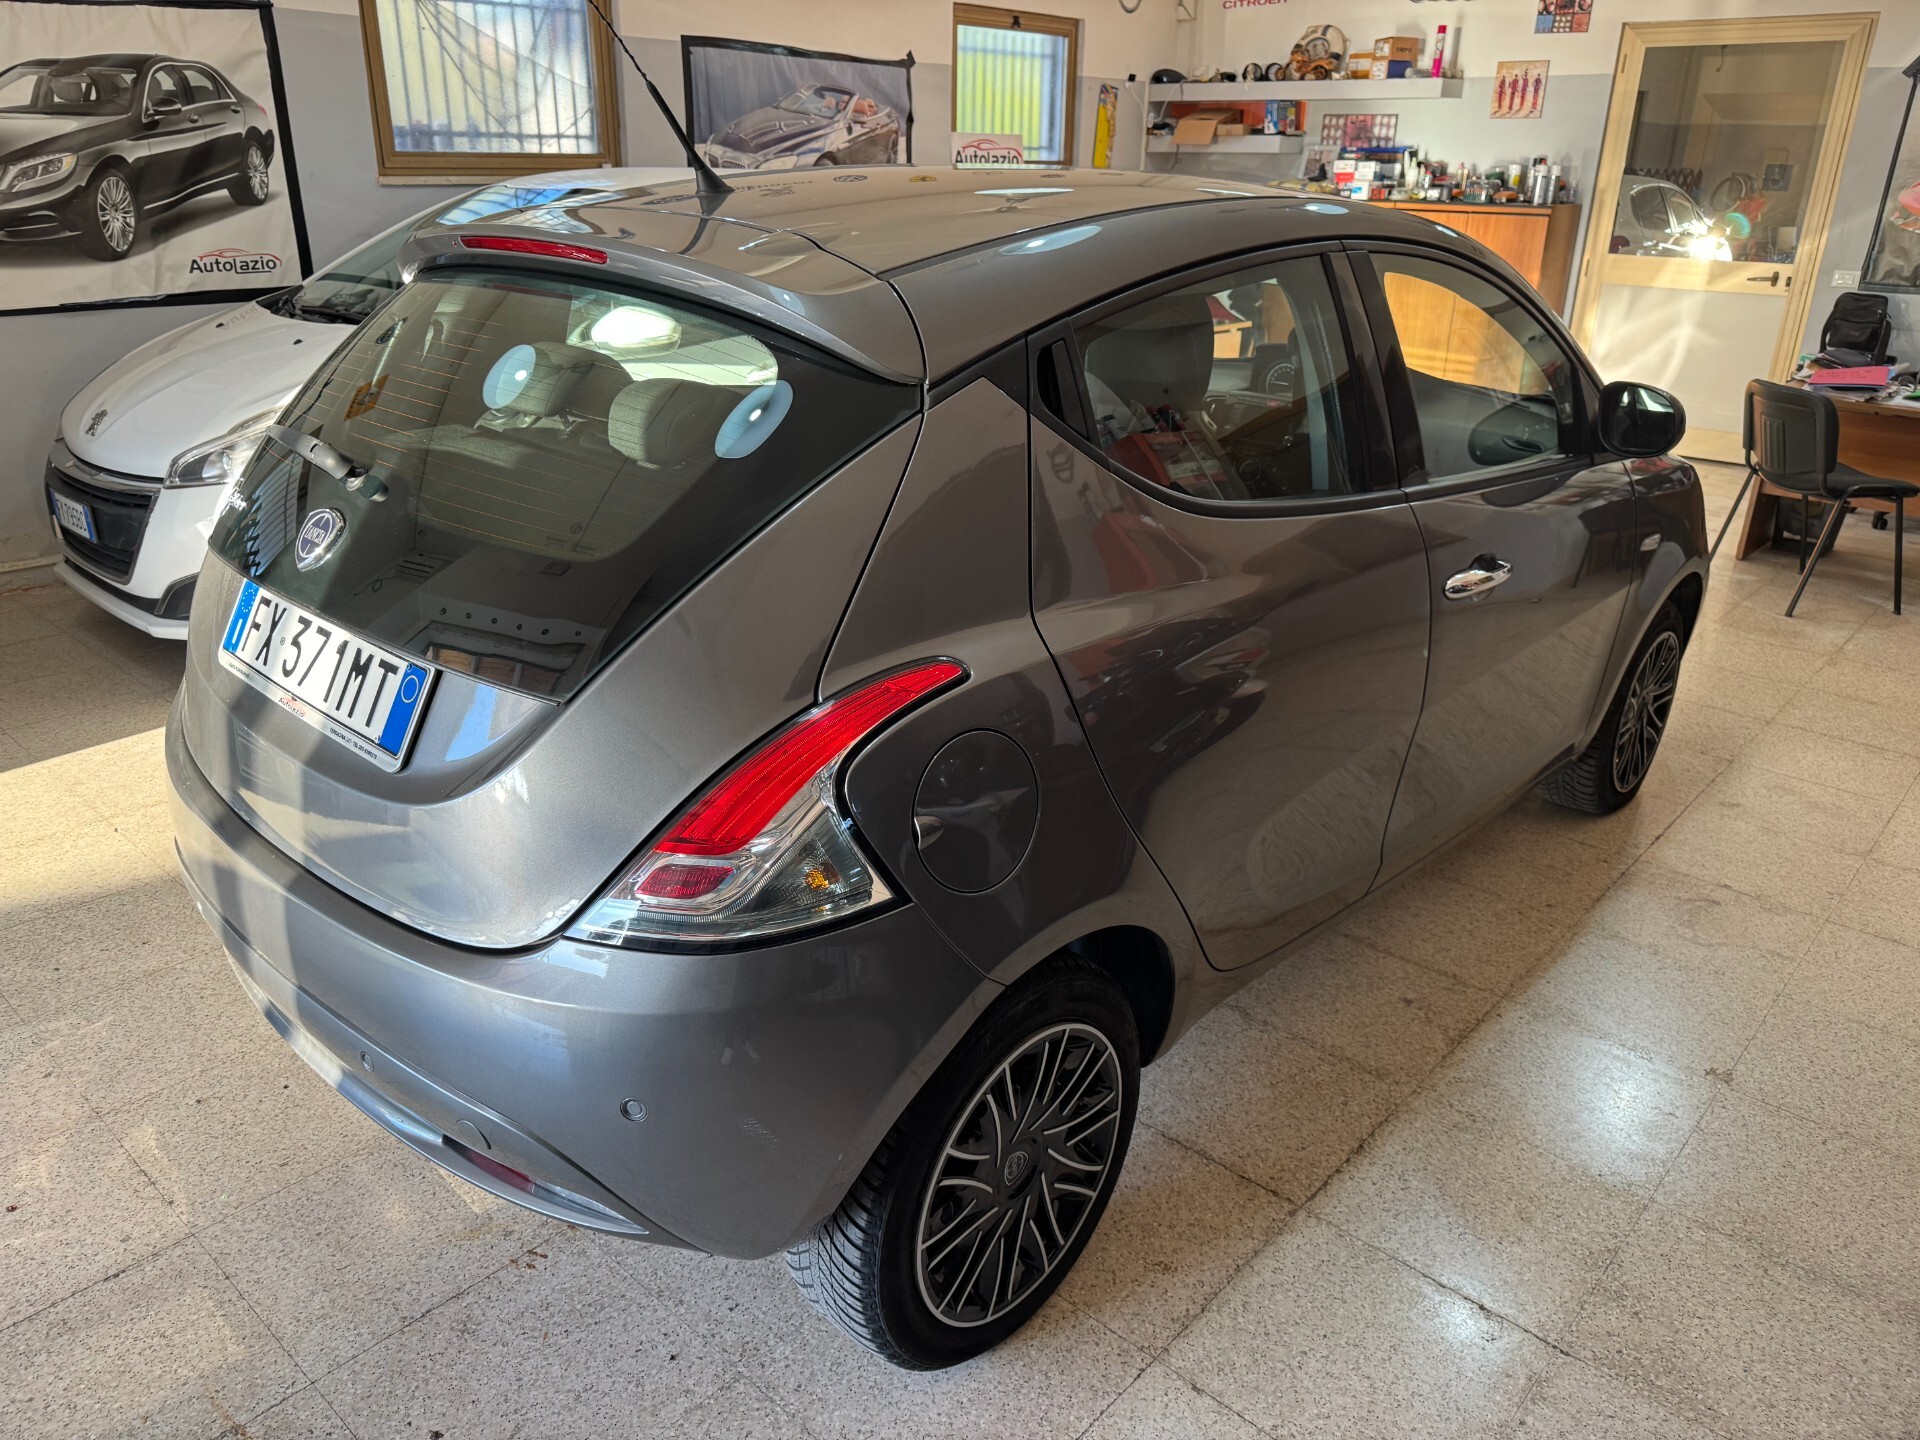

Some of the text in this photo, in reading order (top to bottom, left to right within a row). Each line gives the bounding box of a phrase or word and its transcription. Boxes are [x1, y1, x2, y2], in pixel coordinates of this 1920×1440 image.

[304, 525, 326, 544] LANCIA
[241, 596, 400, 728] FX 371MT
